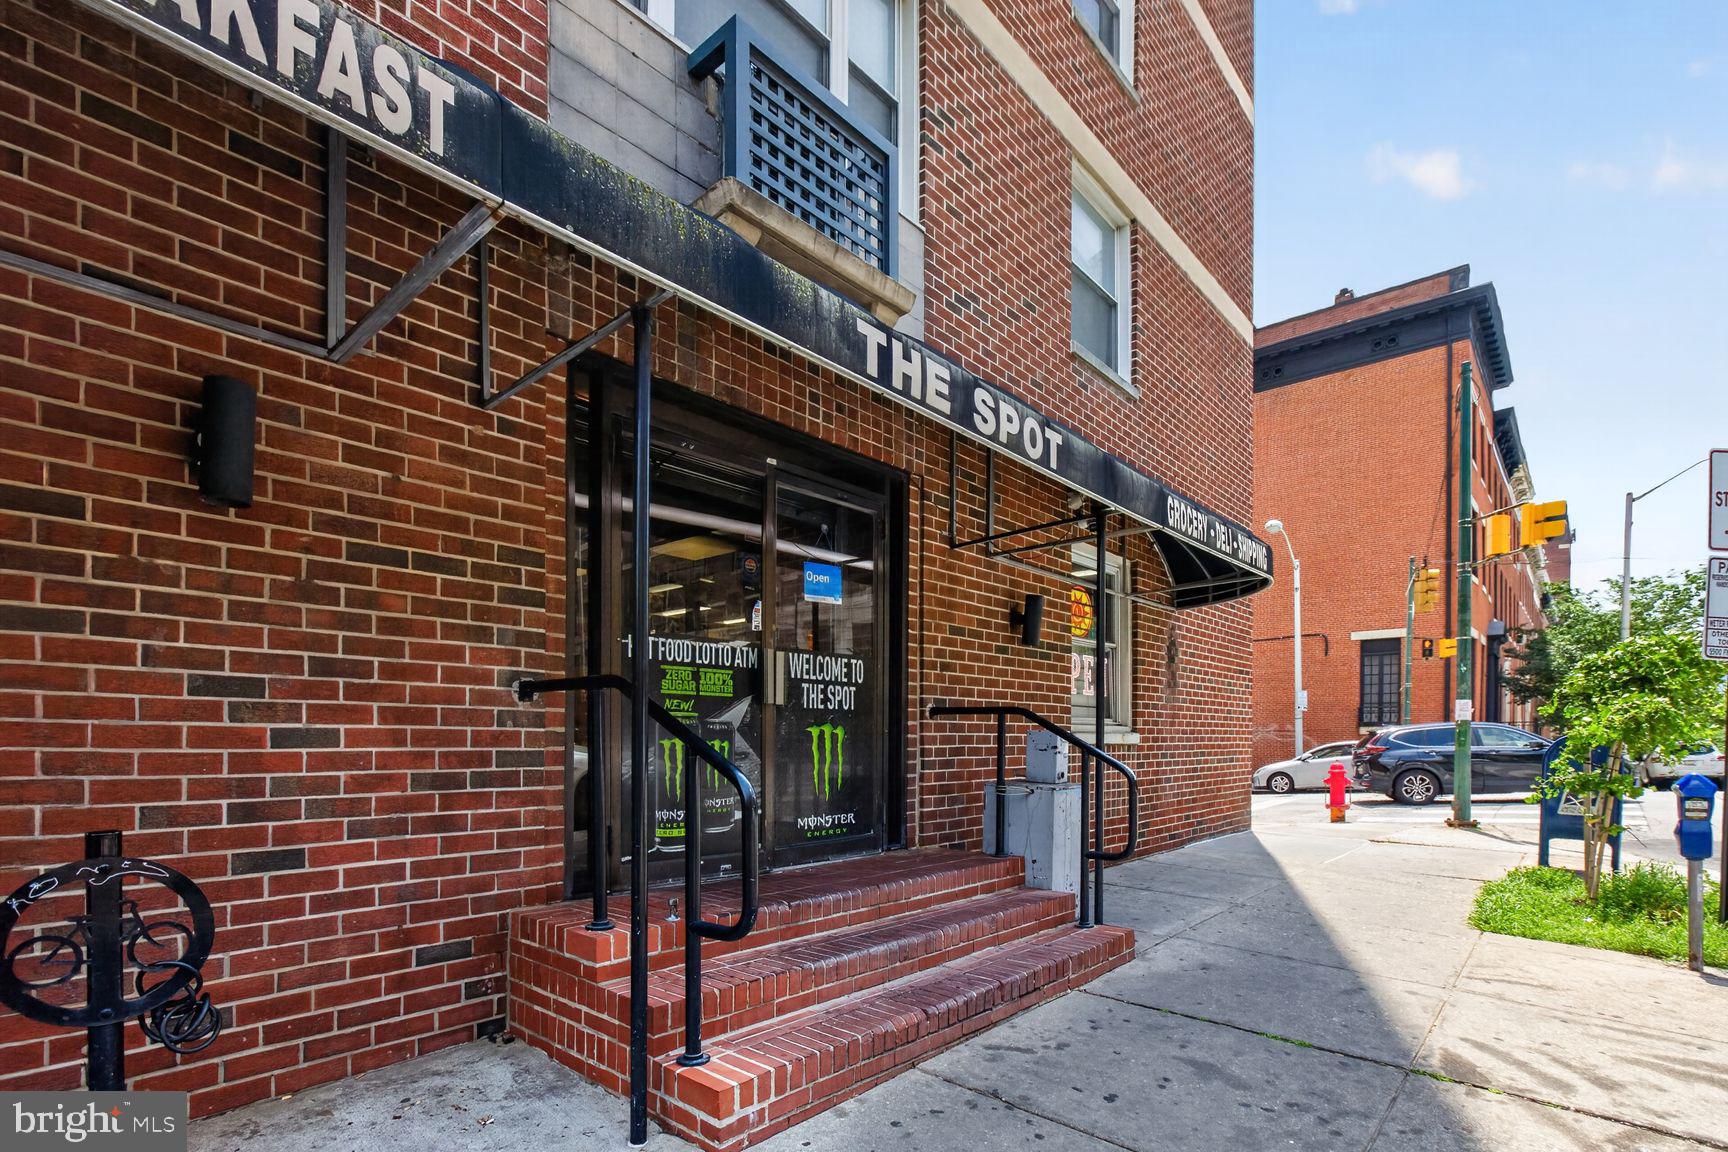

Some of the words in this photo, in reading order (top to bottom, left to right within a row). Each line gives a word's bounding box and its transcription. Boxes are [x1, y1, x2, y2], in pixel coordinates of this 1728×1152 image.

[856, 318, 953, 416] THE
[973, 386, 1064, 471] SPOT
[1167, 495, 1208, 543] GROCERY
[1215, 521, 1233, 555] DELI
[1238, 533, 1268, 572] SHIPPING
[806, 570, 830, 584] Open
[658, 638, 692, 663] FOOD
[696, 641, 732, 667] LOTTO
[734, 645, 758, 669] ATM
[665, 669, 692, 681] ZERO
[789, 652, 848, 683] WELCOME
[850, 659, 864, 684] TO
[661, 680, 697, 692] SUGAR
[699, 672, 733, 686] 100%
[699, 684, 733, 693] MONSTER
[802, 683, 825, 709] THE
[827, 685, 856, 711] SPOT
[664, 699, 695, 712] NEW!
[797, 812, 856, 831] MONSTER
[807, 827, 848, 838] ENERGY
